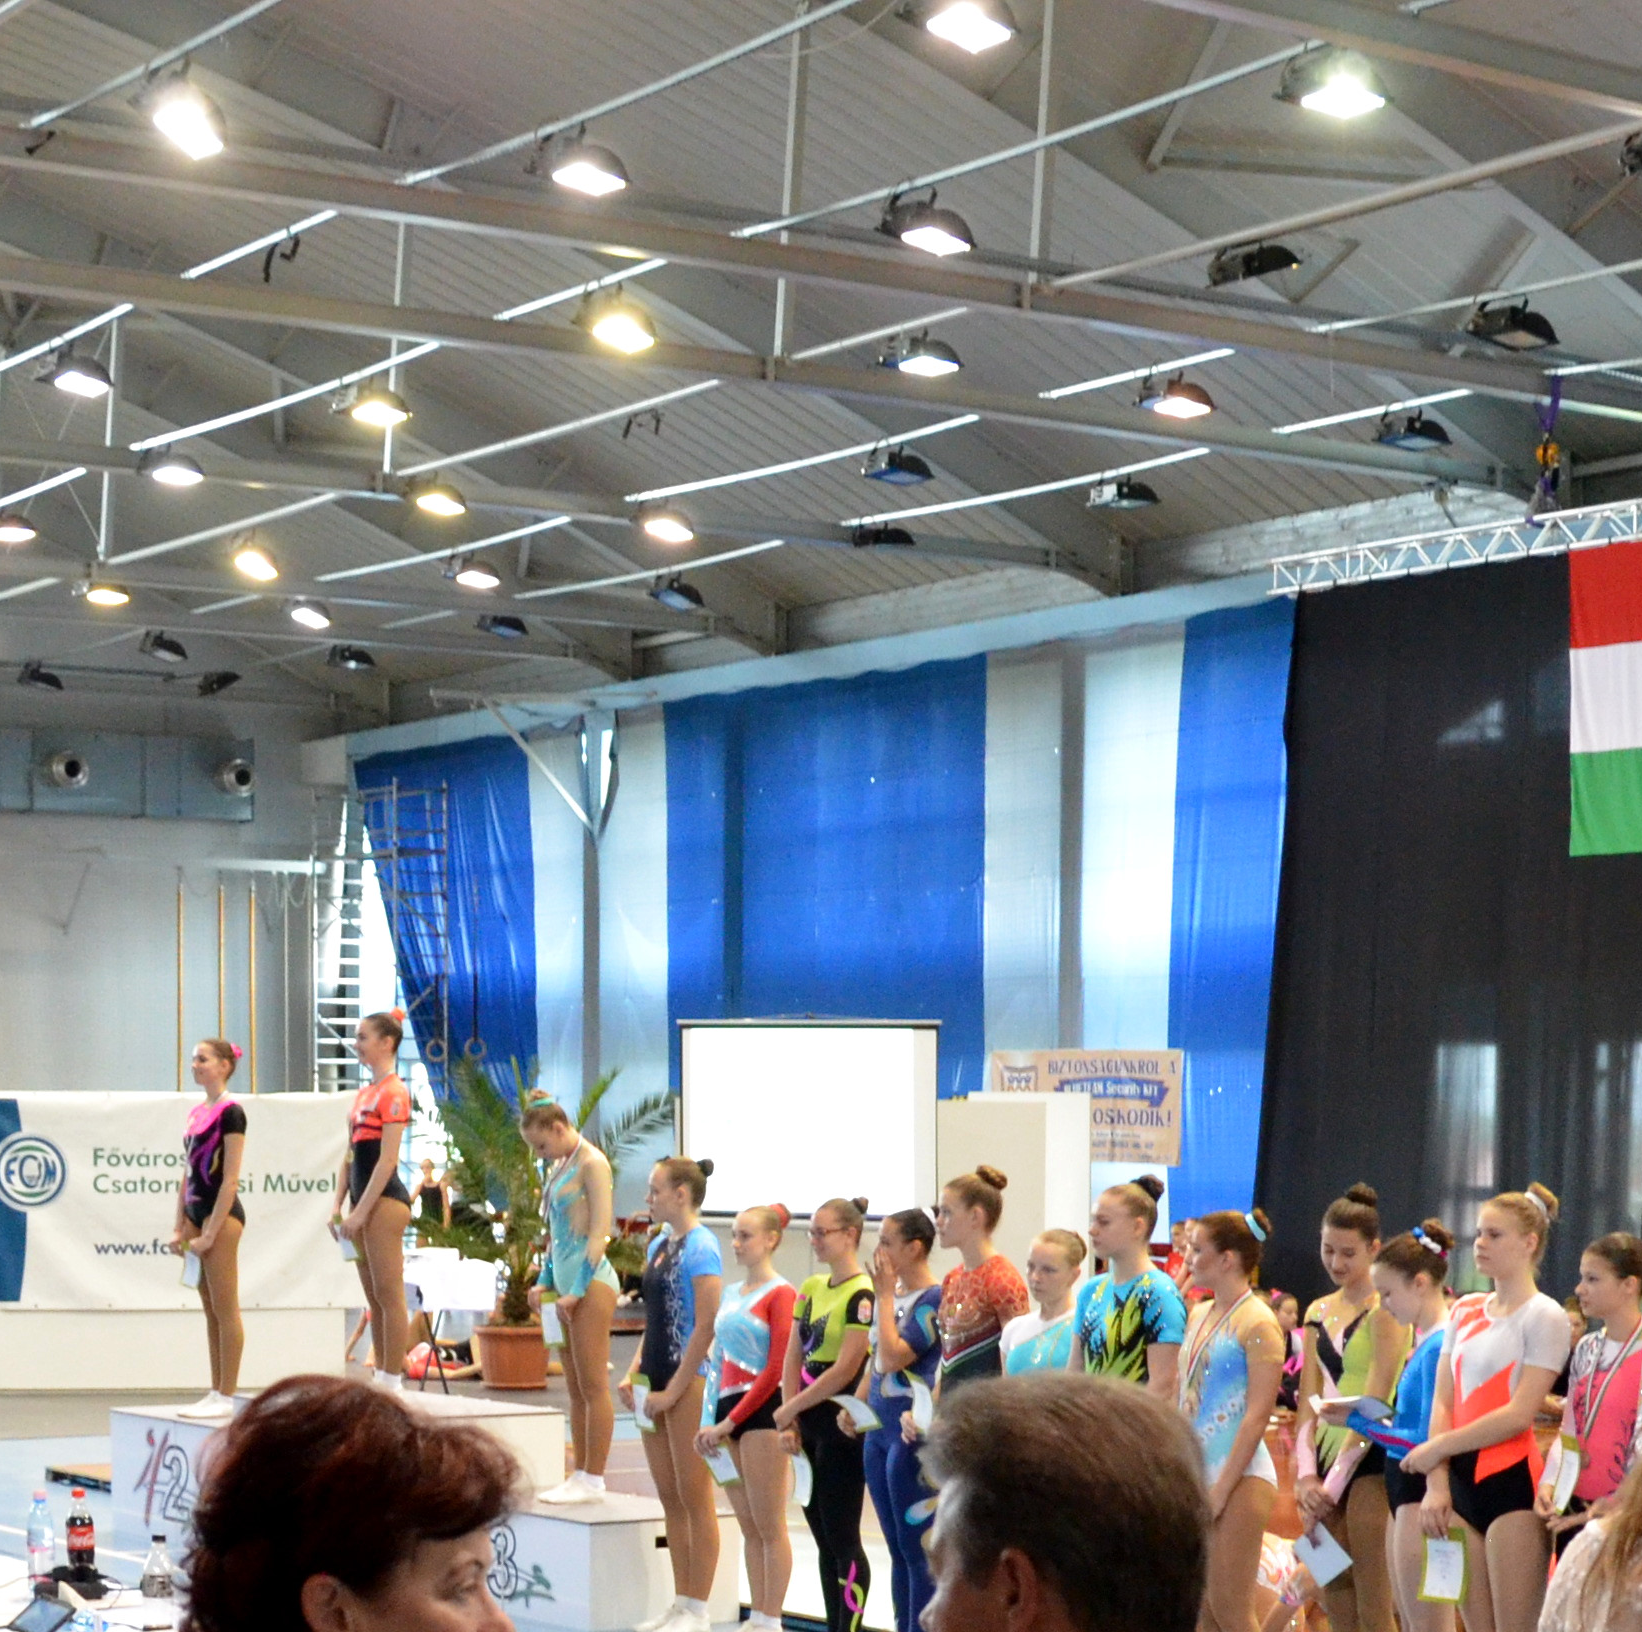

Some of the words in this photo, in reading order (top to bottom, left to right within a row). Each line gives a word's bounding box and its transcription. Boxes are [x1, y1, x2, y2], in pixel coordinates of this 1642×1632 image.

[1092, 1108, 1172, 1128] OSKODIK!
[92, 1147, 187, 1168] Főváros
[262, 1171, 337, 1195] Műve
[94, 1238, 171, 1255] www.fc
[487, 1523, 518, 1600] 3
